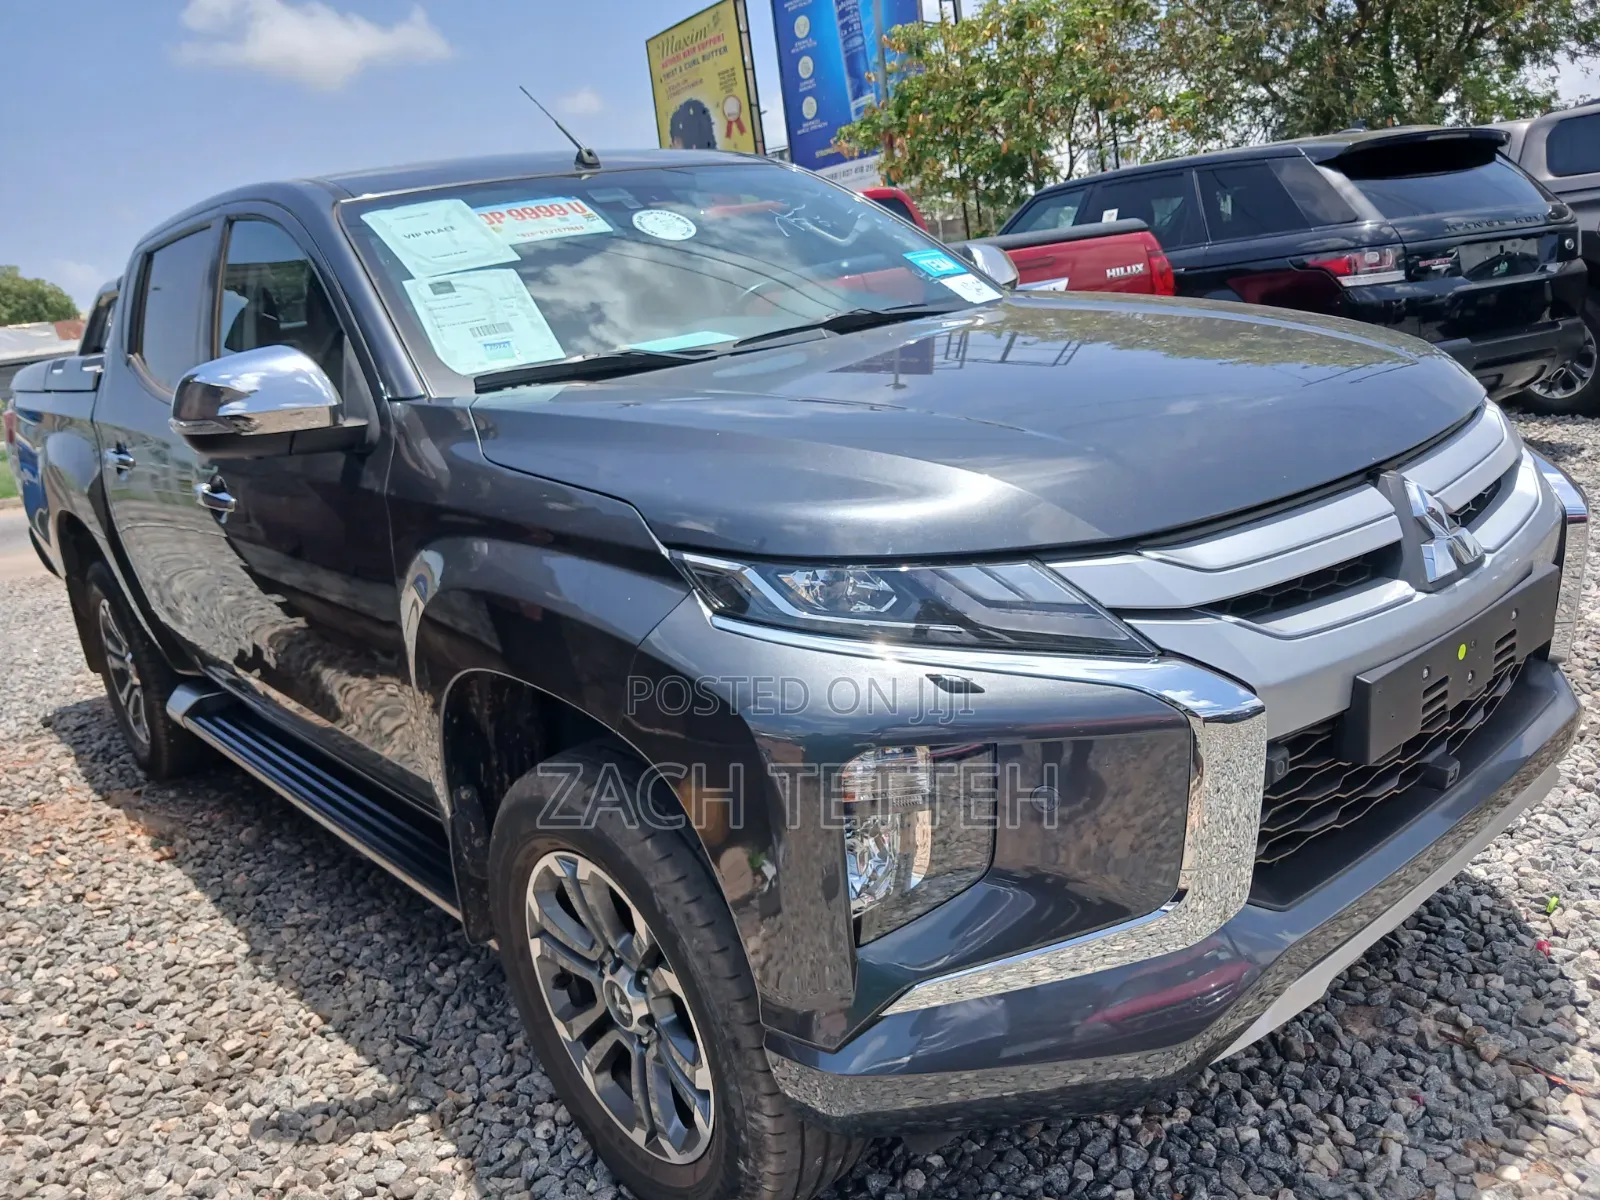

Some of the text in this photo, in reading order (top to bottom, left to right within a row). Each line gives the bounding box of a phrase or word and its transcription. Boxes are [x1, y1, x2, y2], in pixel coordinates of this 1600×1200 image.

[506, 203, 569, 222] 9999
[565, 201, 588, 214] U
[403, 225, 457, 239] VIP PLACE
[1105, 262, 1144, 279] HILUX
